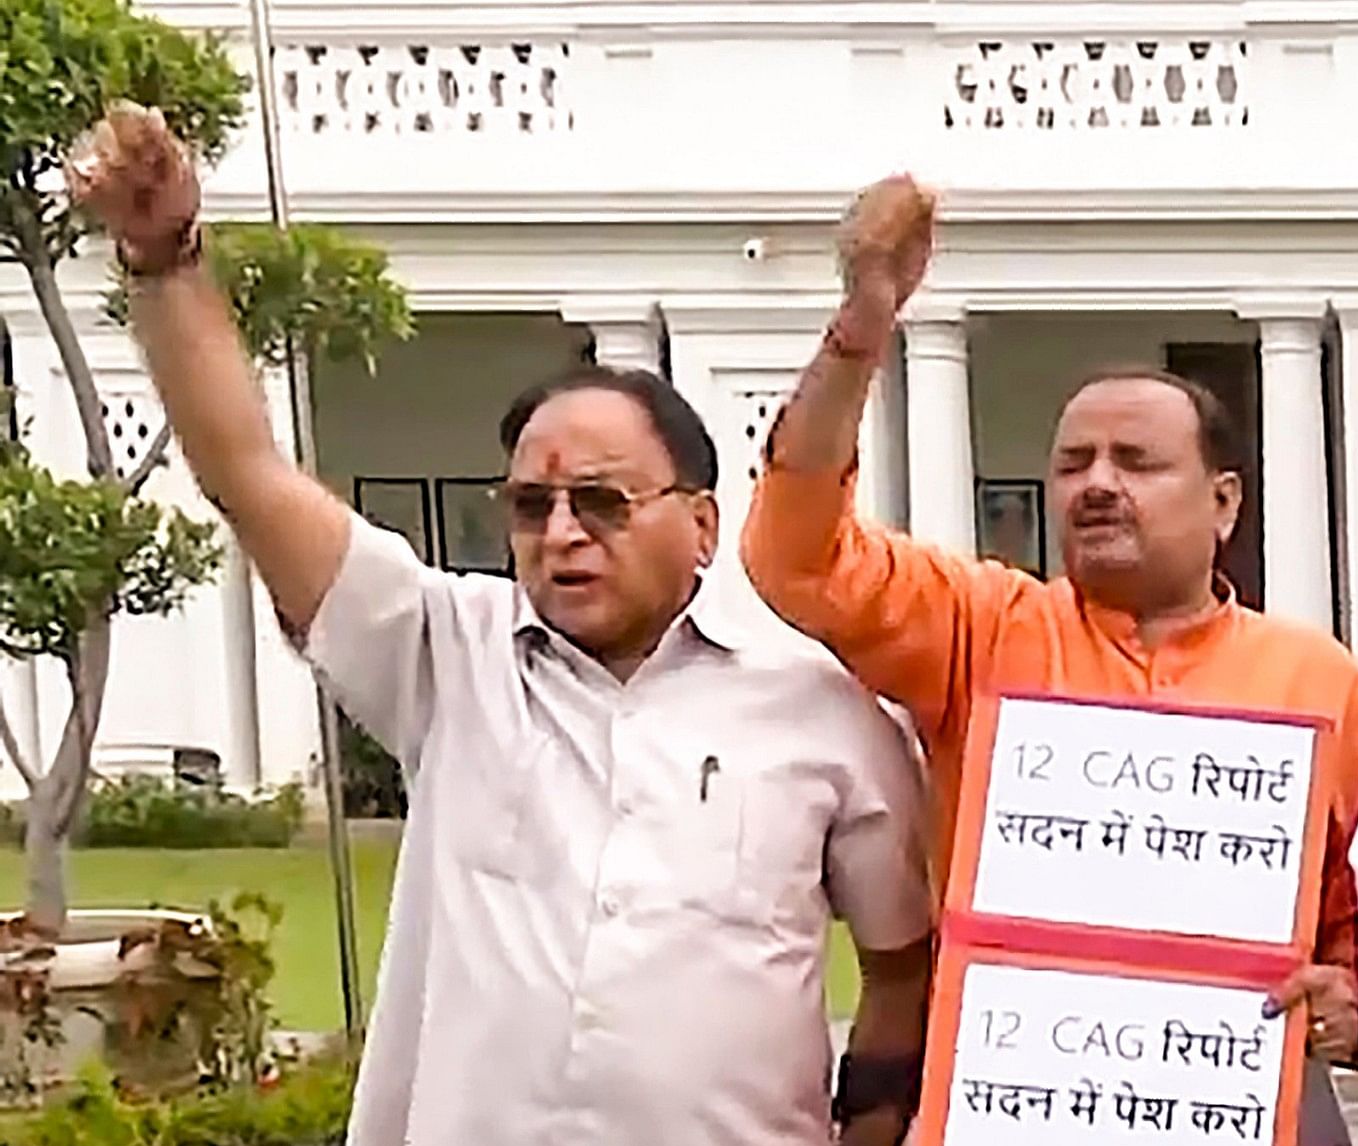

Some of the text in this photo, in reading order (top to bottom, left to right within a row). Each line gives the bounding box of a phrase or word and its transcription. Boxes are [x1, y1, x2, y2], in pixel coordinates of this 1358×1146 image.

[1012, 743, 1293, 804] 12 CAG रिपोर्ट
[997, 809, 1293, 870] सदन में पेश करो
[979, 1009, 1266, 1072] 12 CAG रिपोर्ट
[962, 1078, 1267, 1140] सदन में पेश करो
